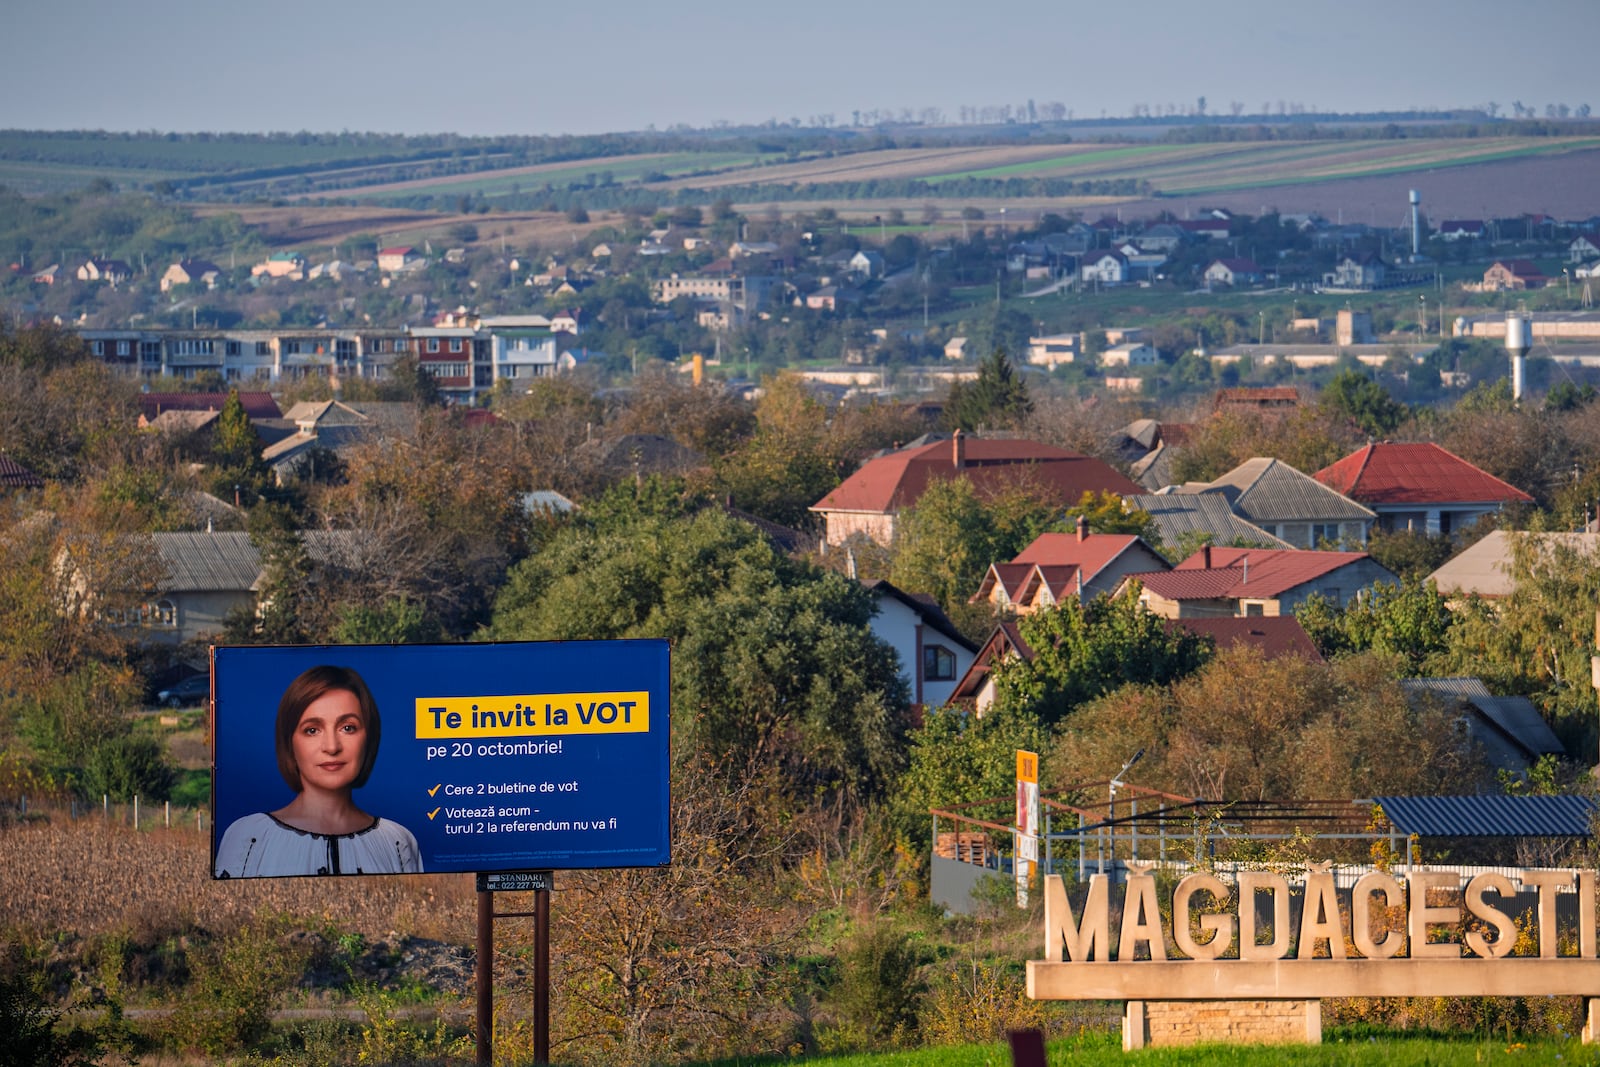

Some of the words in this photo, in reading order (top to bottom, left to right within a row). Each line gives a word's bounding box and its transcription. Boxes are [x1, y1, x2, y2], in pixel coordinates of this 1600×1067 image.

[428, 707, 462, 729] Te
[472, 704, 536, 728] invit
[545, 704, 569, 726] la
[575, 701, 637, 725] VOT
[426, 745, 447, 761] pe
[451, 743, 473, 758] 20
[477, 739, 563, 757] octombrie!
[445, 784, 474, 796] Cere
[477, 784, 485, 795] 2
[487, 782, 536, 795] buletine
[539, 781, 555, 793] de
[557, 780, 579, 792] vot
[445, 805, 496, 819] Votează
[498, 806, 531, 817] acum
[445, 823, 474, 835] turul
[476, 822, 485, 834] 2
[487, 821, 498, 833] la
[500, 819, 571, 833] referendum
[573, 820, 588, 831] nu
[591, 820, 606, 830] va
[609, 818, 617, 830] fi
[501, 881, 516, 890] 022
[516, 881, 529, 889] 227
[532, 881, 545, 889] 704
